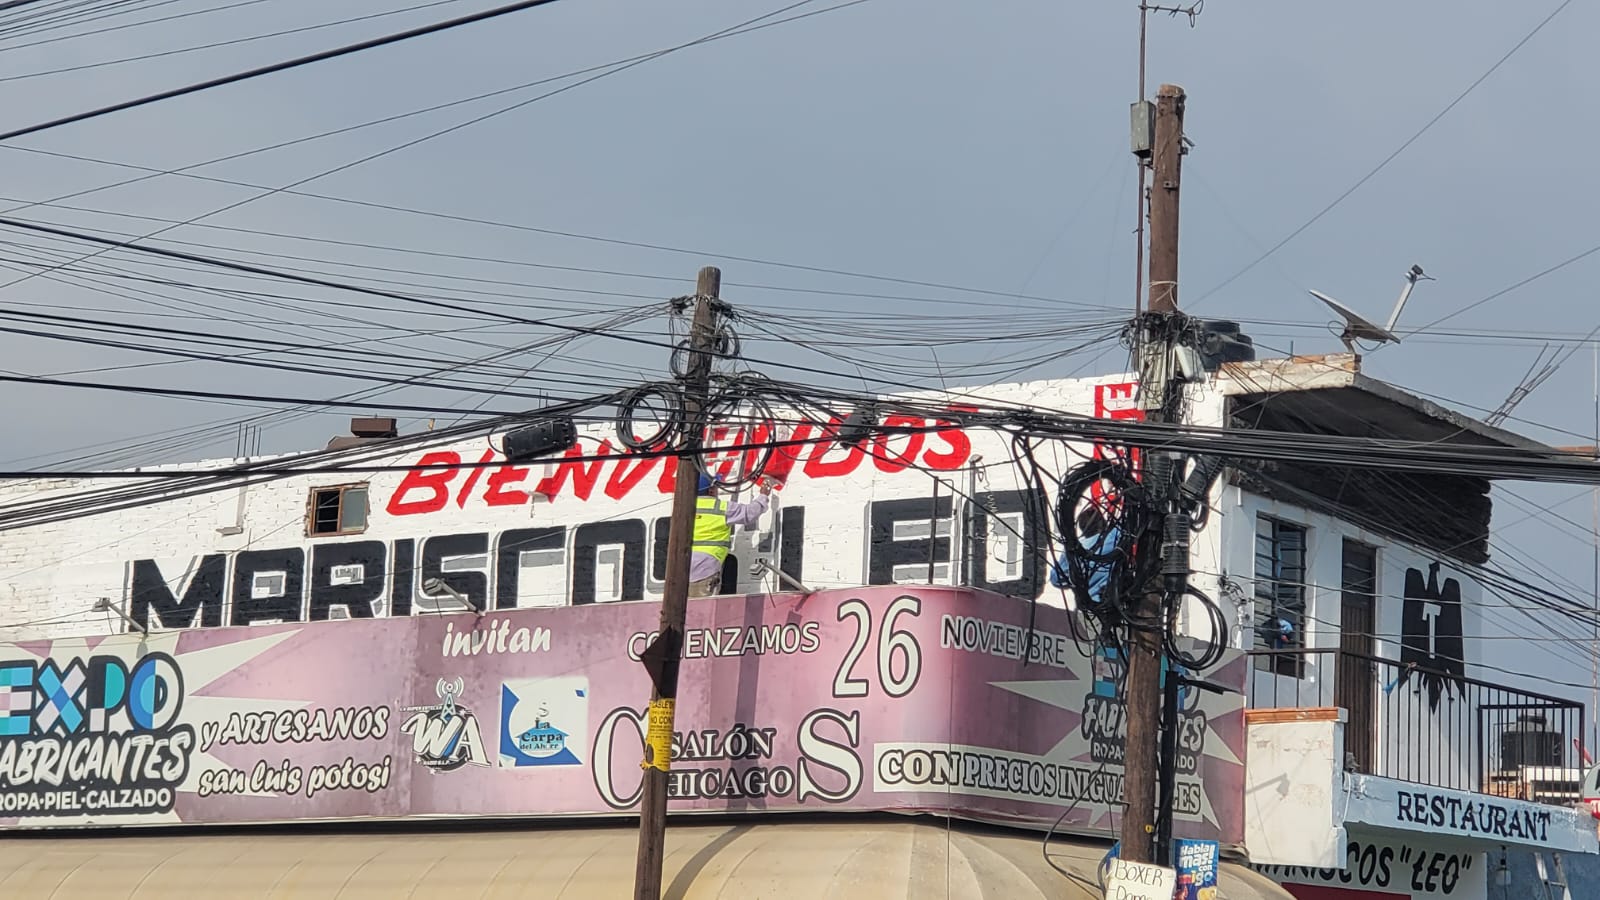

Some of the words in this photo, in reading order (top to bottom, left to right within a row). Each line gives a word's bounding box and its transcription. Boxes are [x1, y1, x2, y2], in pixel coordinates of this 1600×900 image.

[442, 619, 551, 657] invitan
[627, 622, 820, 662] CENZAMOS
[832, 595, 922, 698] 26
[942, 615, 1066, 667] NOVIEMBRE
[0, 652, 183, 733] EXPO
[221, 706, 390, 745] ARTESANOS
[521, 731, 563, 744] Carpa
[0, 731, 192, 786] ABRICANTES
[199, 769, 245, 797] san
[251, 760, 300, 793] luis
[306, 756, 391, 798] potosi
[879, 750, 960, 785] CON
[963, 754, 1060, 798] PRECIOS
[1397, 791, 1550, 841] RESTAURANT
[1180, 843, 1211, 856] Habla
[1115, 860, 1163, 887] BOXER
